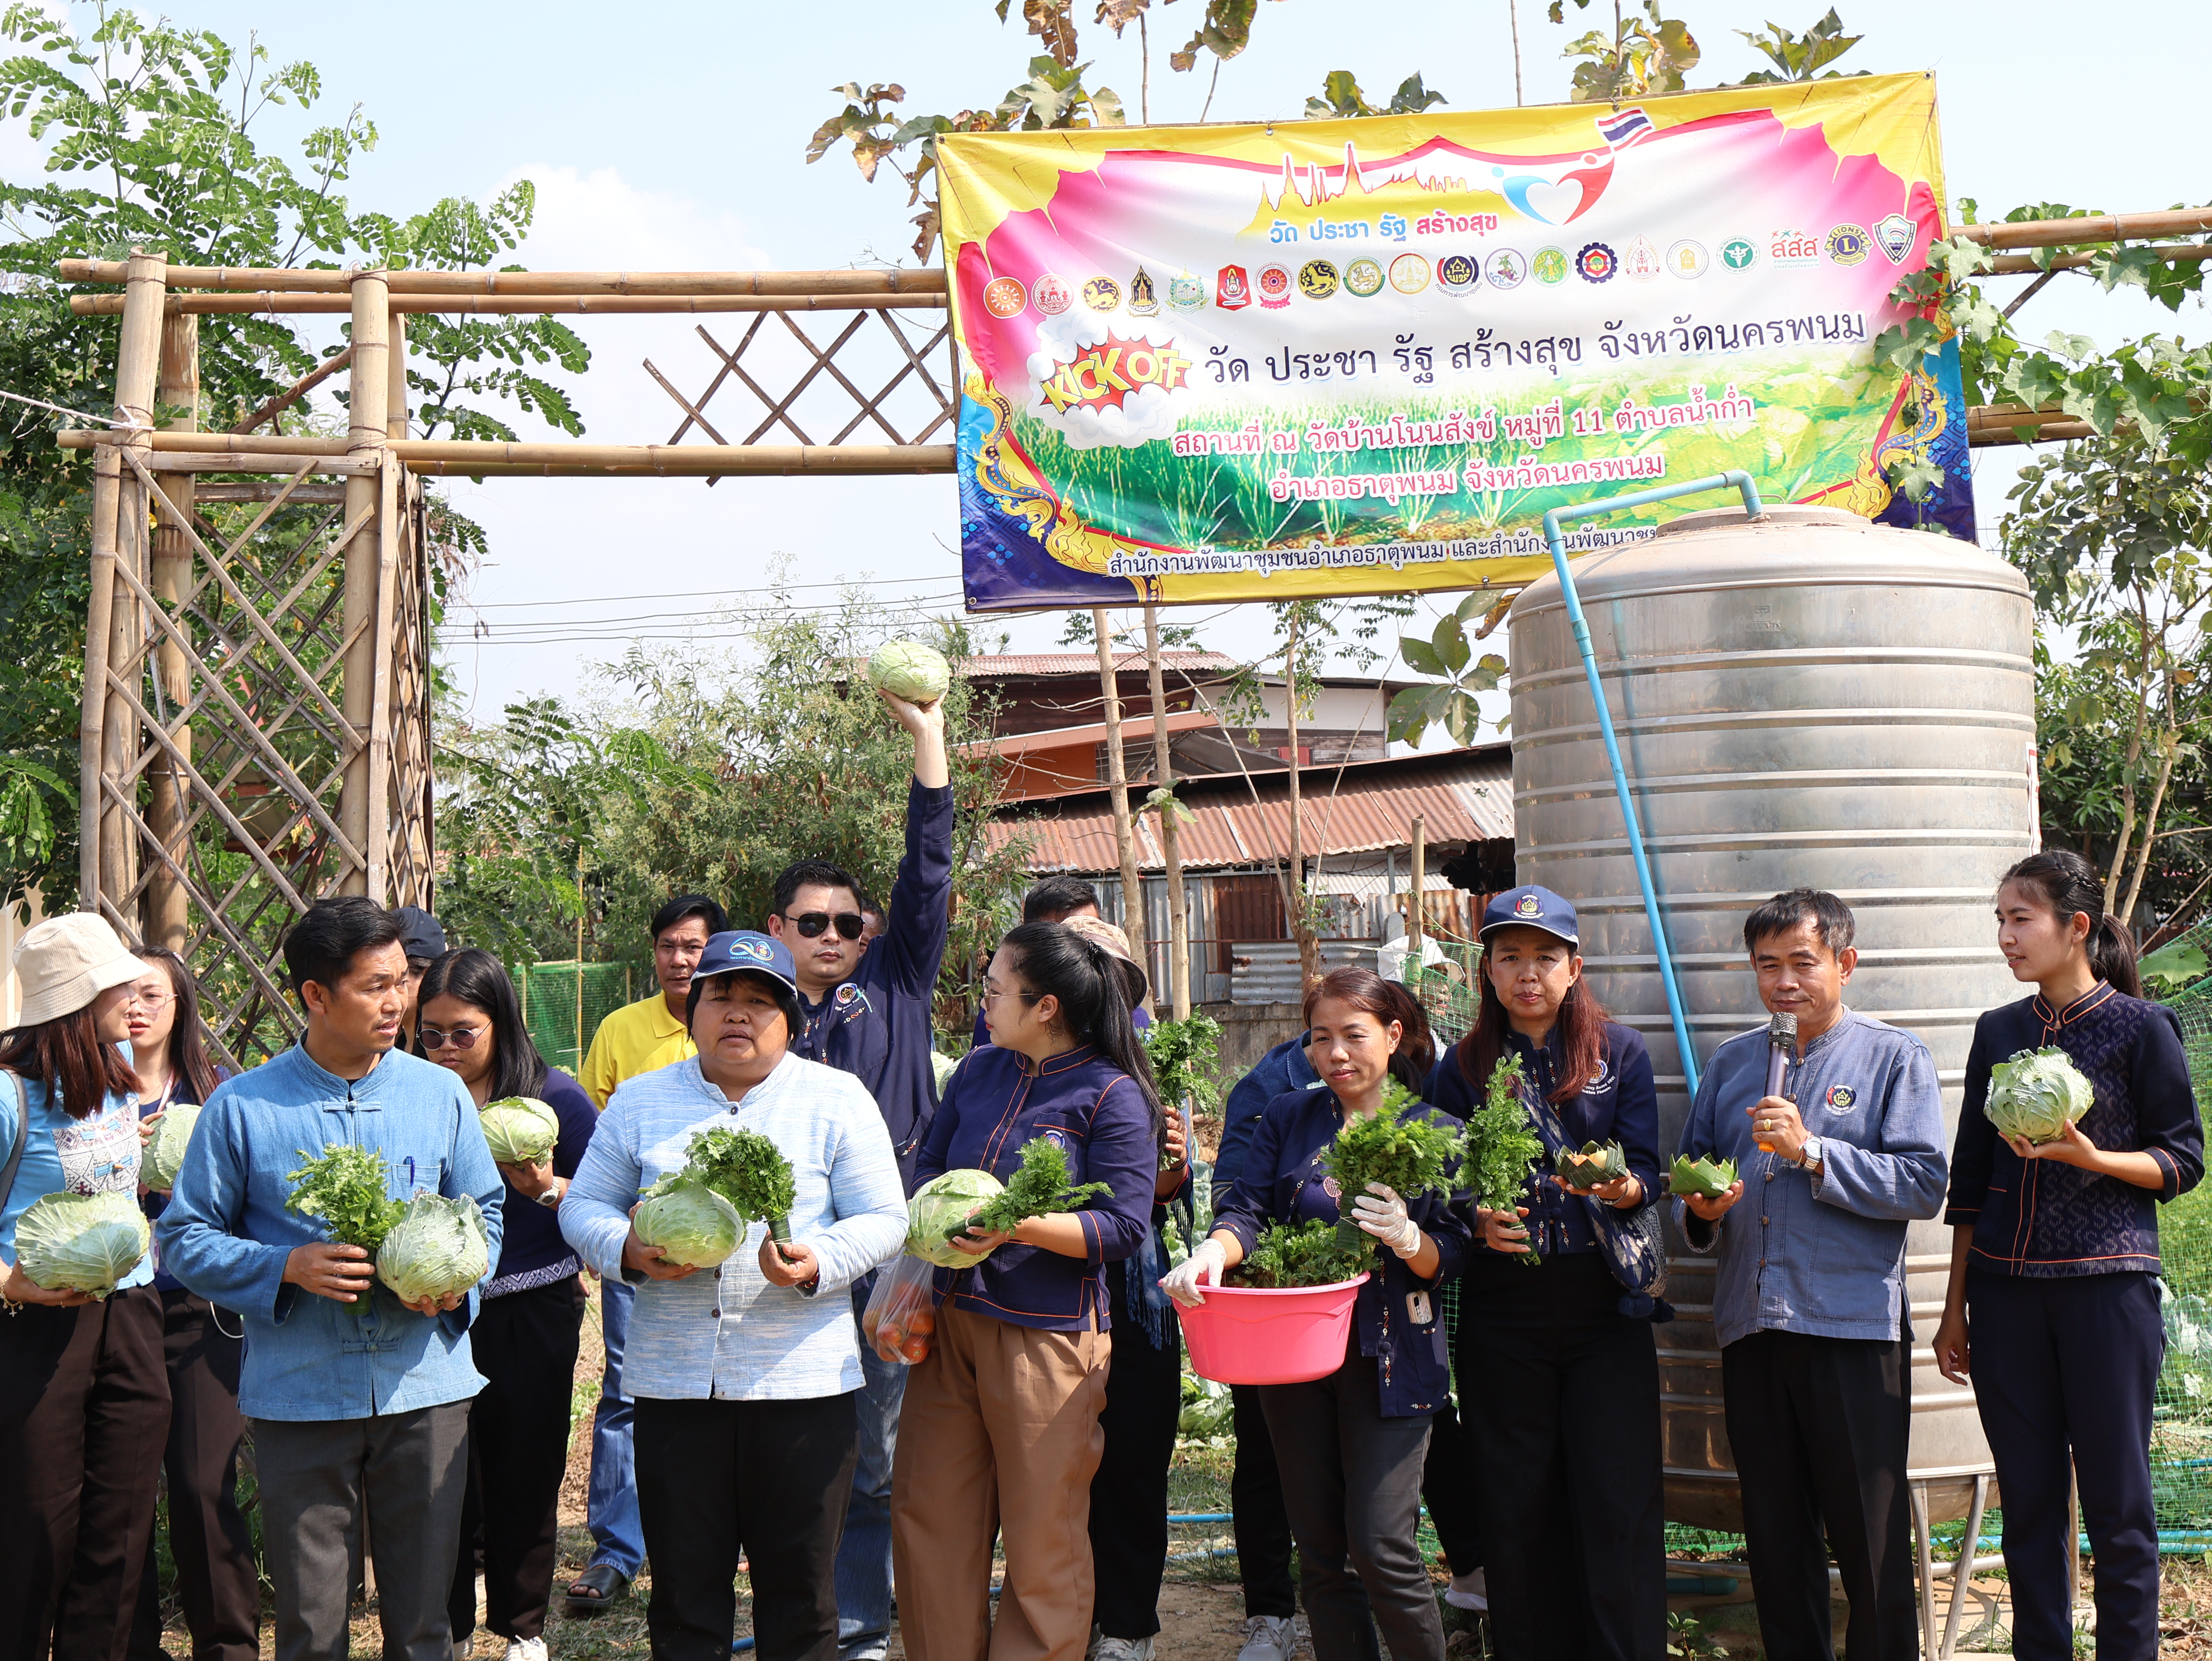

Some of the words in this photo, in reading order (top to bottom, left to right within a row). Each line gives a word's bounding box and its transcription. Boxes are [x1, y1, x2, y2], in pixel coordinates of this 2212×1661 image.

[1270, 221, 1298, 243] วัด
[1309, 220, 1369, 241] ประชา
[1380, 215, 1406, 242] รัฐ
[1417, 211, 1498, 237] สร้างสุข
[1833, 227, 1860, 236] LIONS
[1842, 238, 1856, 252] L
[1435, 282, 1483, 298] กรมการพัฒนาชุมชน
[1205, 345, 1250, 383] วัด
[1265, 345, 1377, 381] ประชา
[1392, 333, 1434, 384] รัฐ
[1449, 328, 1581, 376] สร้างสุข
[1598, 313, 1865, 360] จังหวัดนครพนม
[1041, 347, 1134, 414] KICK
[1126, 347, 1192, 389] OFF
[1174, 419, 1261, 454] สถานที่
[1272, 433, 1297, 451] ณ
[1307, 411, 1494, 450] วัดบ้านโนนสังข์
[1505, 400, 1561, 446] หมู่ที่
[1574, 410, 1604, 433] 11
[1616, 386, 1753, 430] ตำบลน้ำก่ำ
[1271, 472, 1454, 503] อำเภอธาตุพนม
[1465, 453, 1662, 489] จังหวัดนครพนม
[1110, 542, 1444, 573] สำนักงานพัฒนาชุมชนอำเภอธาตุพนม
